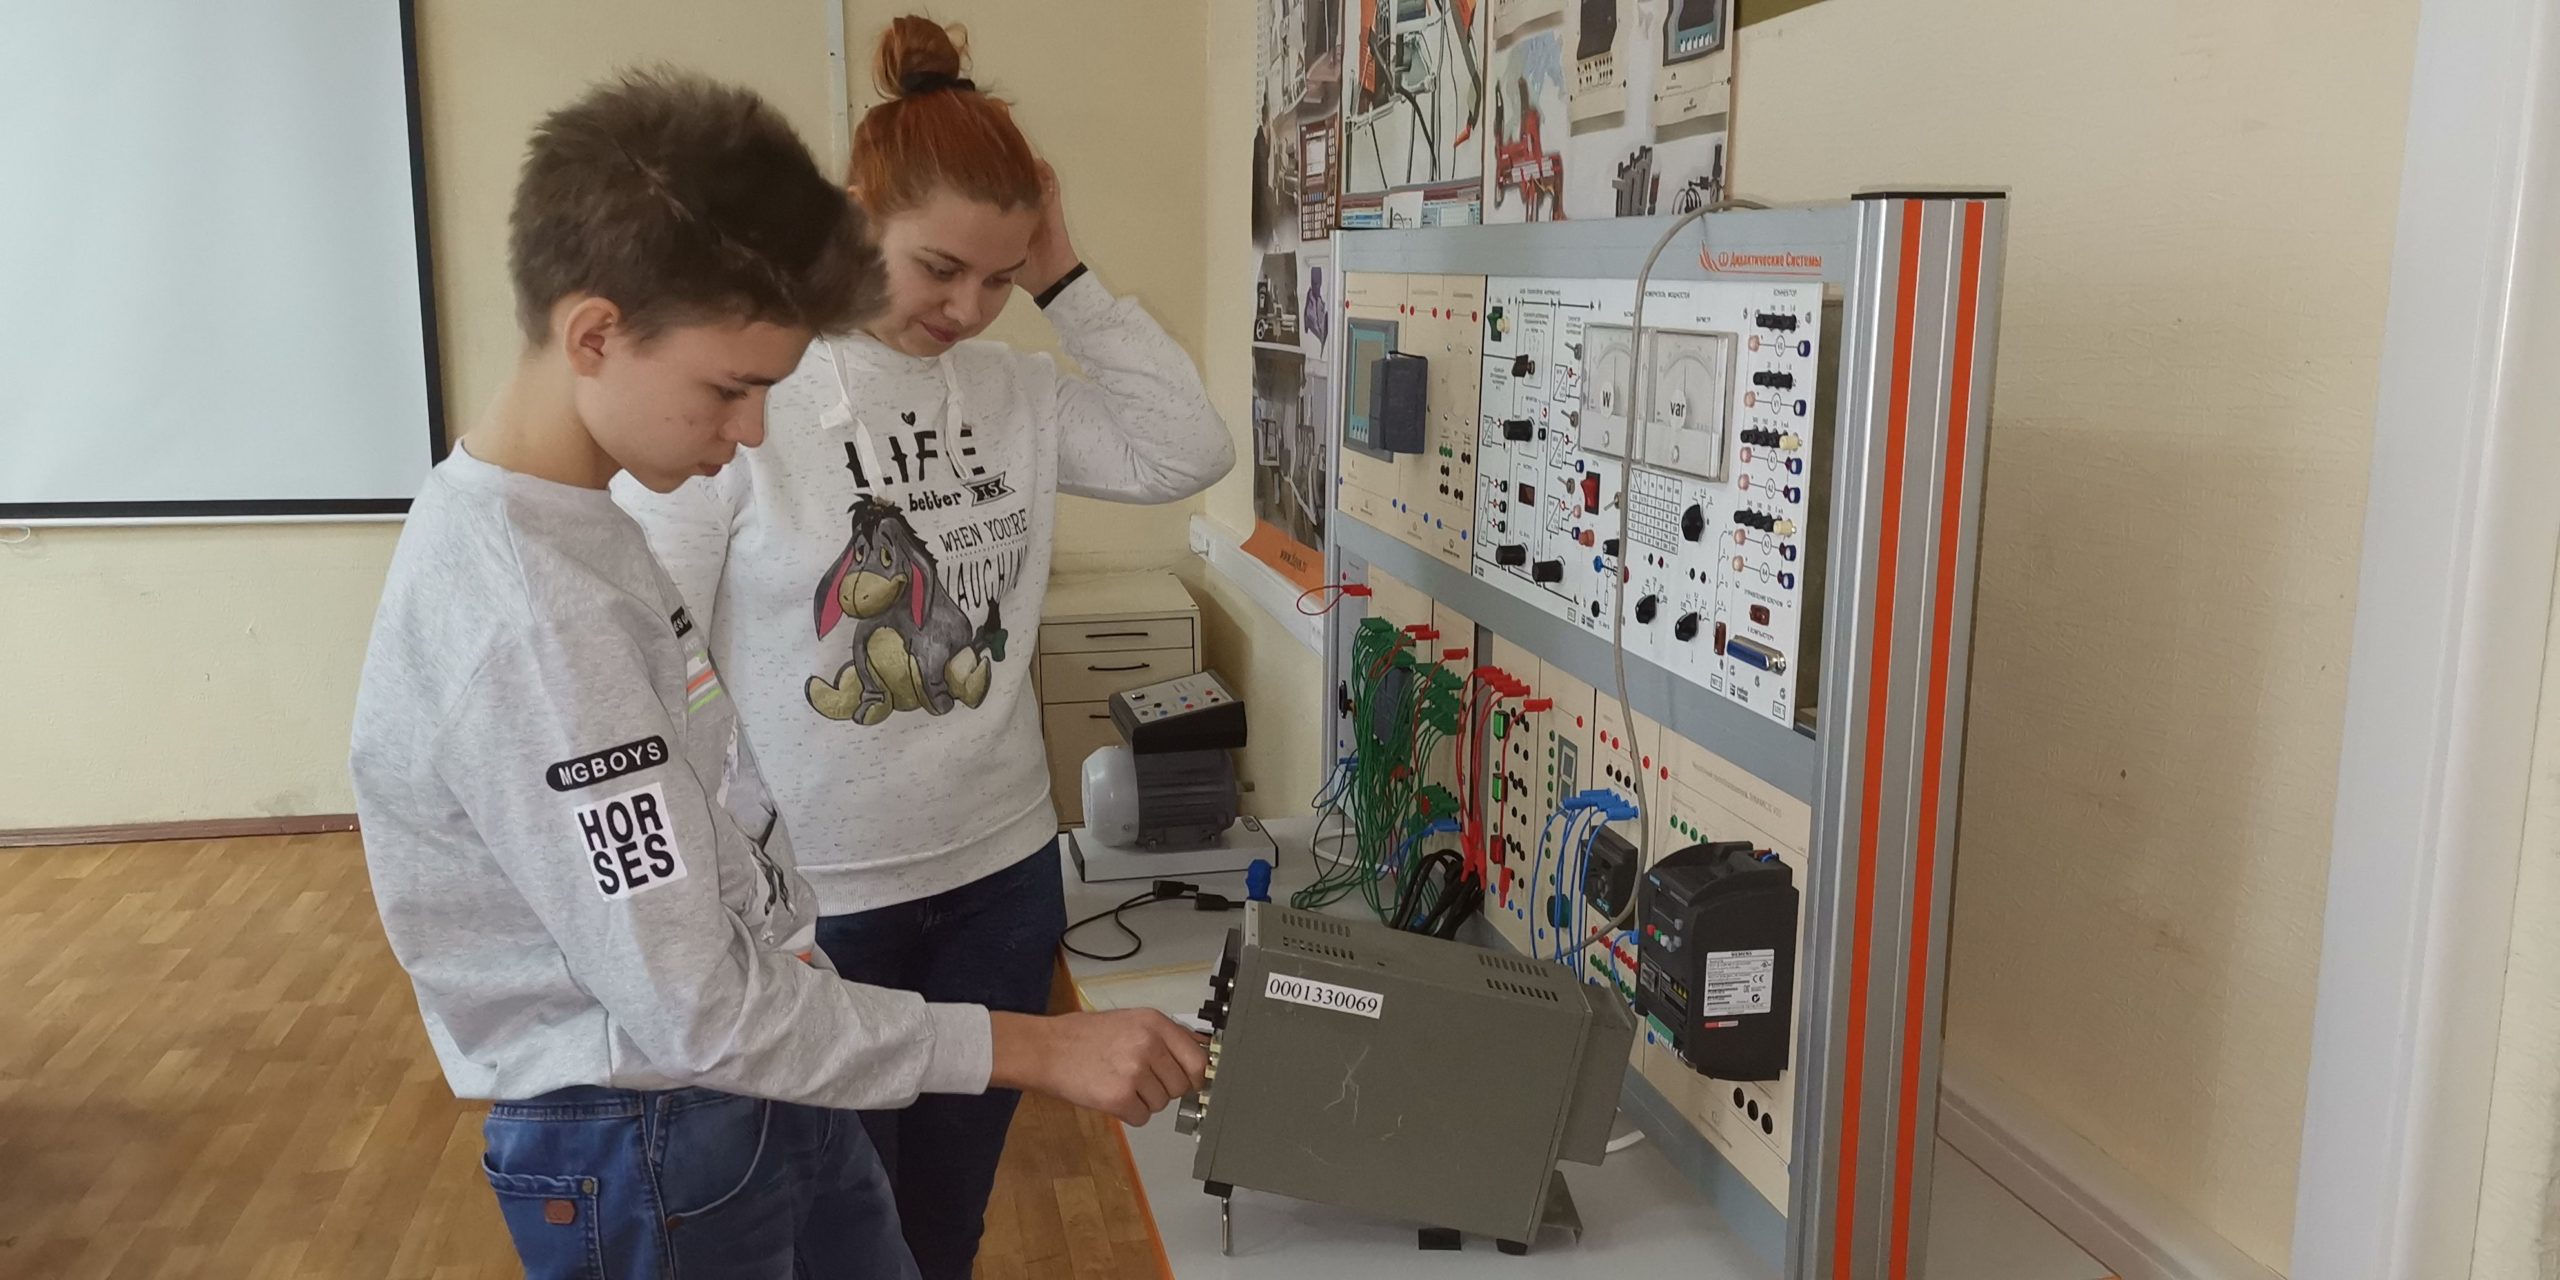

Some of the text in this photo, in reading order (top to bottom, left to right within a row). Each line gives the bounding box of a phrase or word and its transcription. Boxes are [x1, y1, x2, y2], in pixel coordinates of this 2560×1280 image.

[1730, 251, 1822, 268] Дидактические Системы
[1602, 390, 1612, 408] W
[1670, 400, 1686, 418] var
[908, 482, 1002, 512] better IS
[939, 508, 1028, 553] WHEN YOU'RE
[577, 792, 664, 852] HOR
[593, 833, 675, 895] SES
[1269, 978, 1378, 1014] 0001330069
